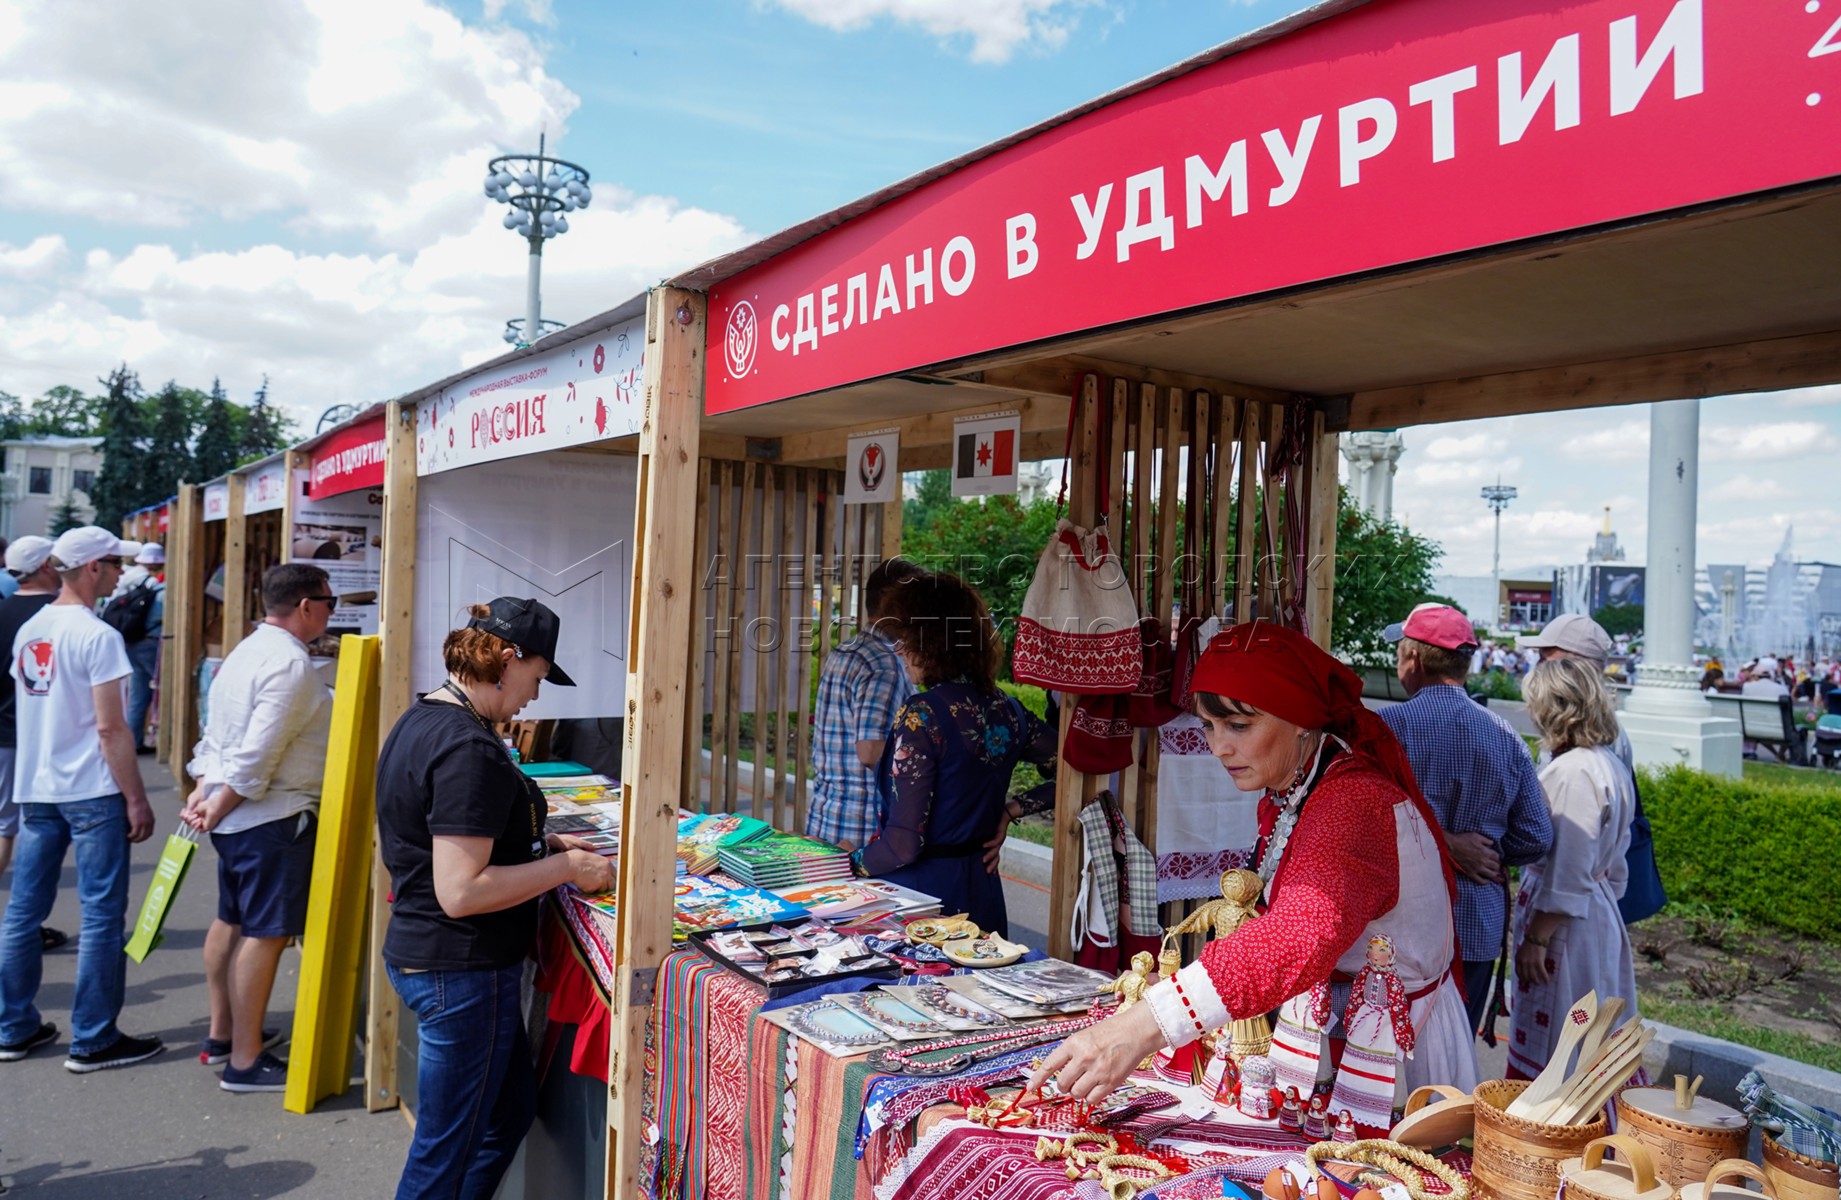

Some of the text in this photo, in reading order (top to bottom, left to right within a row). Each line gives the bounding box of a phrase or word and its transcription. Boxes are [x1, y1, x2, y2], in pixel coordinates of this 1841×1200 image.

[771, 0, 1704, 356] СДЕЛАНО В УДМУРТИИ
[471, 394, 547, 451] РОССИЯ
